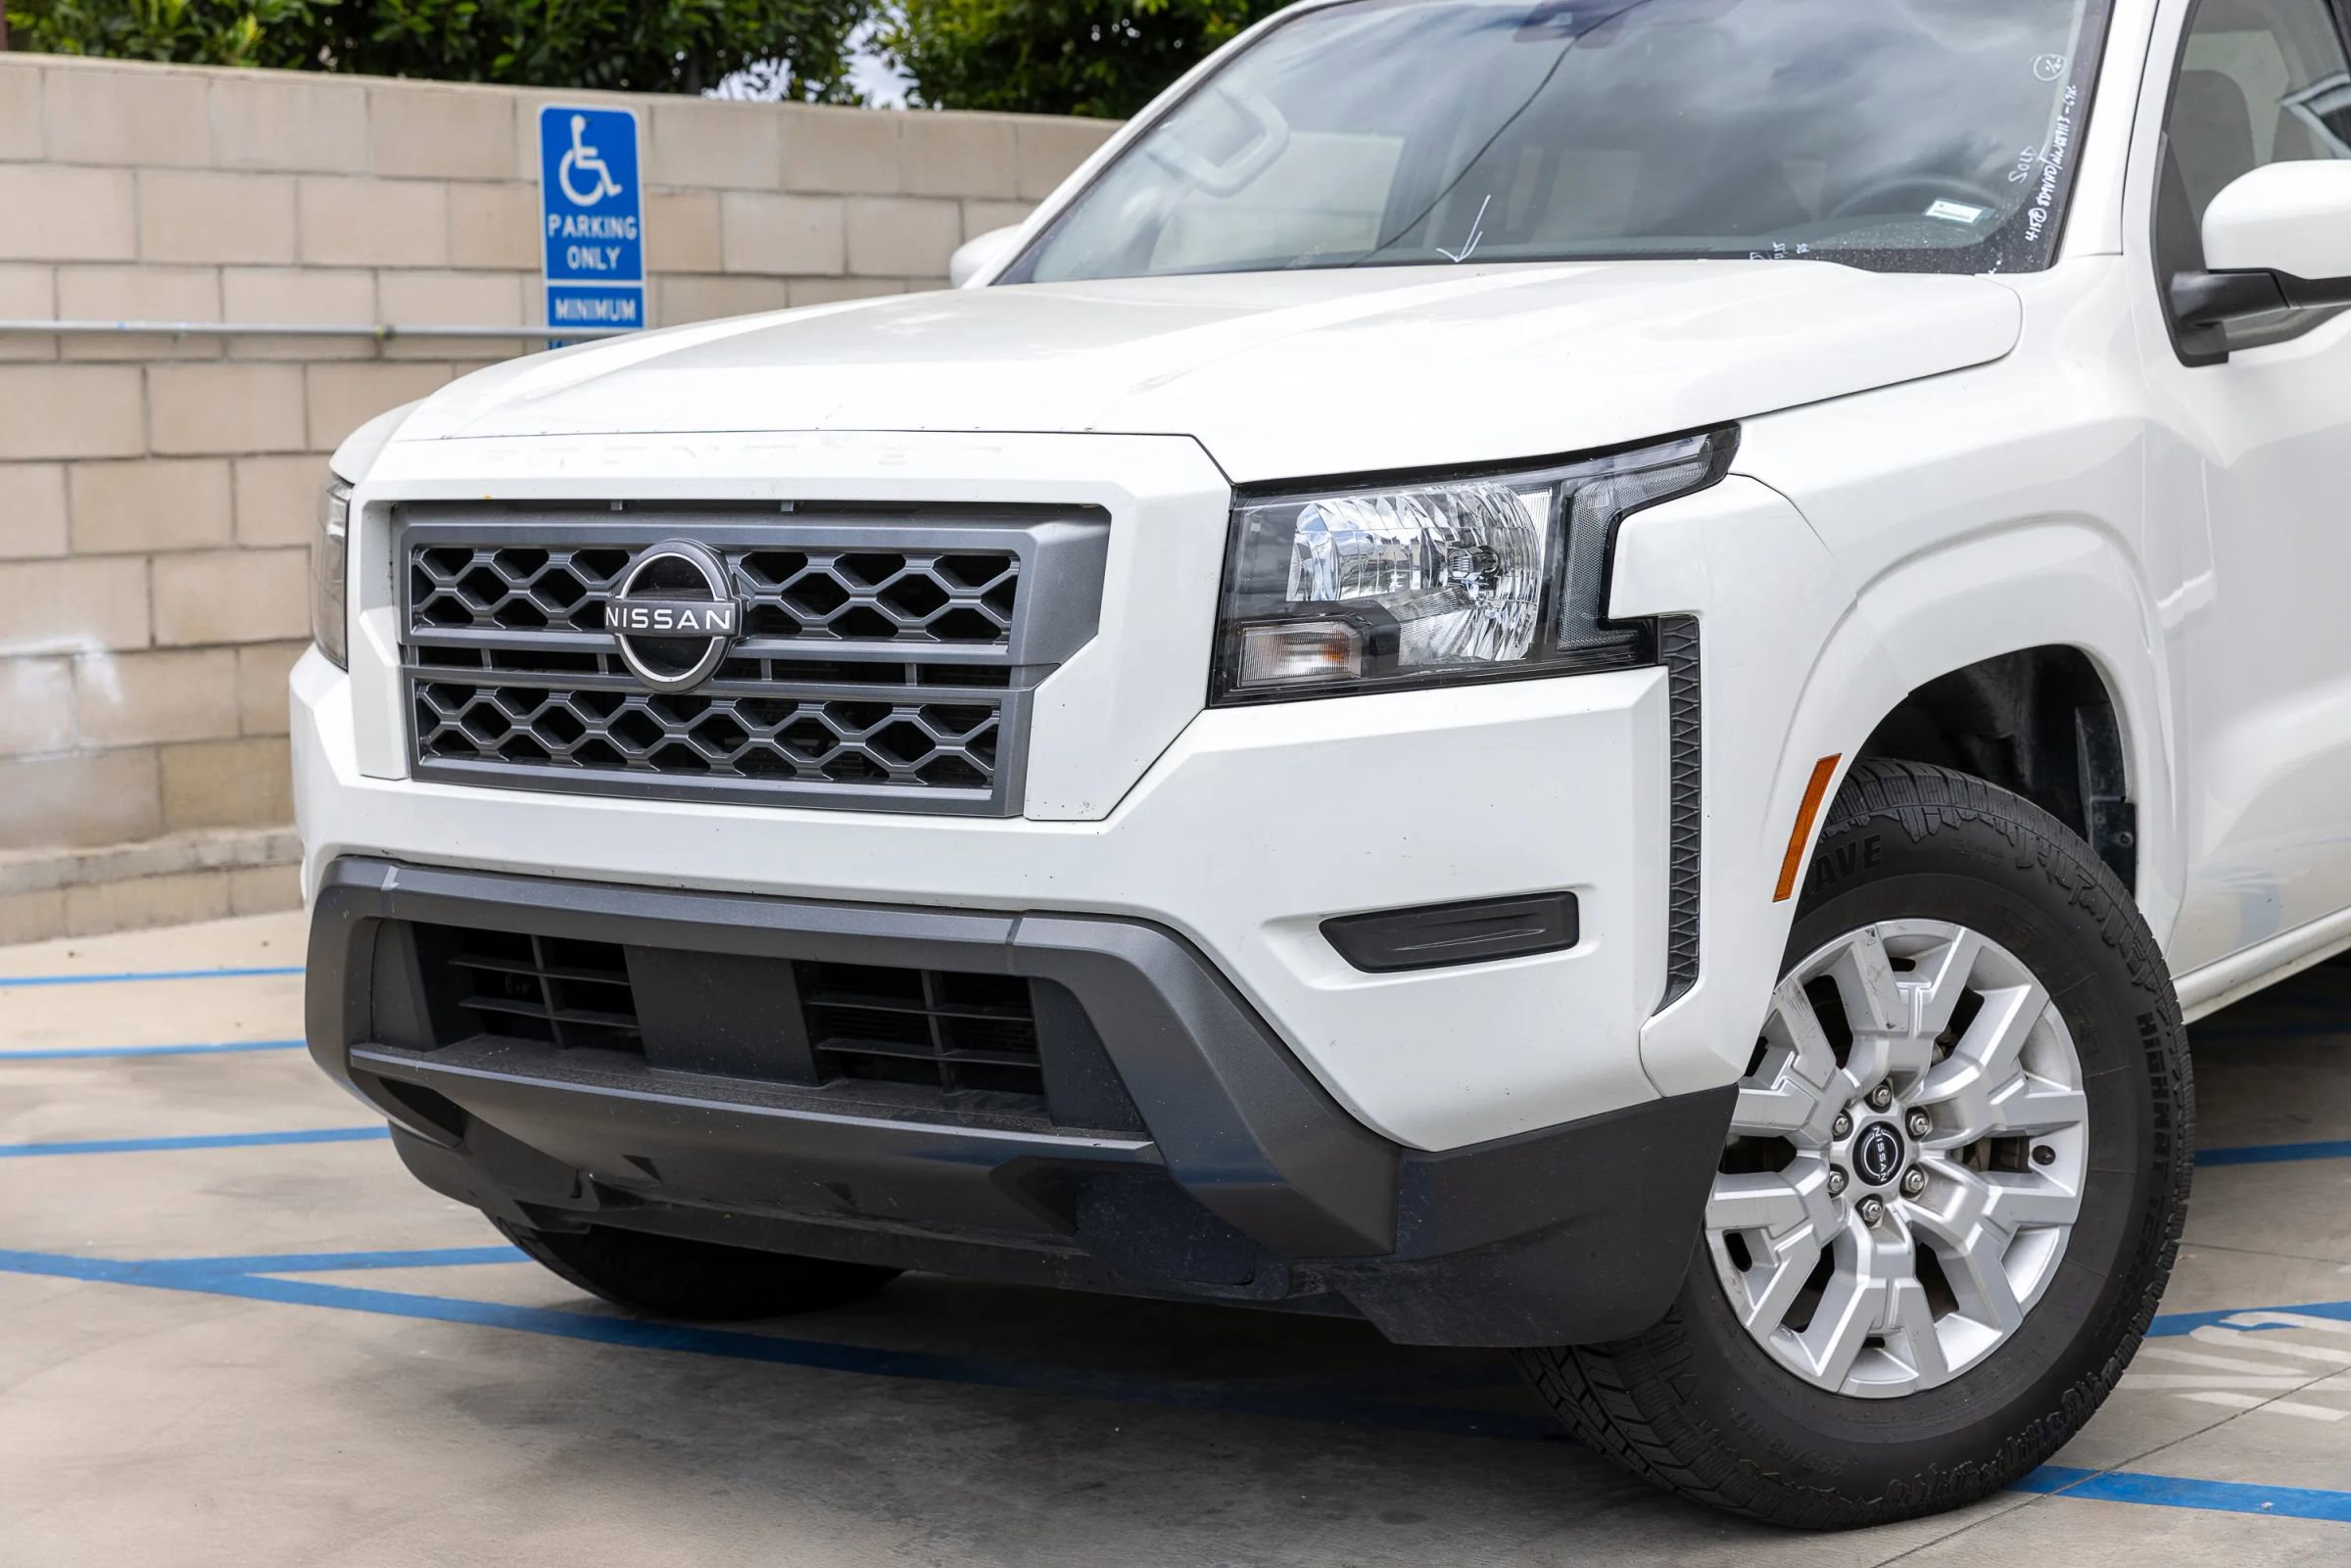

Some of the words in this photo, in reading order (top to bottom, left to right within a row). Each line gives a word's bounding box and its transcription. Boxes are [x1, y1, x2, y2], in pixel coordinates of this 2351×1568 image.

[548, 214, 638, 239] PARKING
[566, 245, 621, 269] ONLY
[554, 297, 636, 321] MINIMUM
[605, 606, 731, 630] NISSAN
[2135, 1011, 2172, 1181] HIGHWAY
[1873, 1126, 1888, 1182] NISSAN
